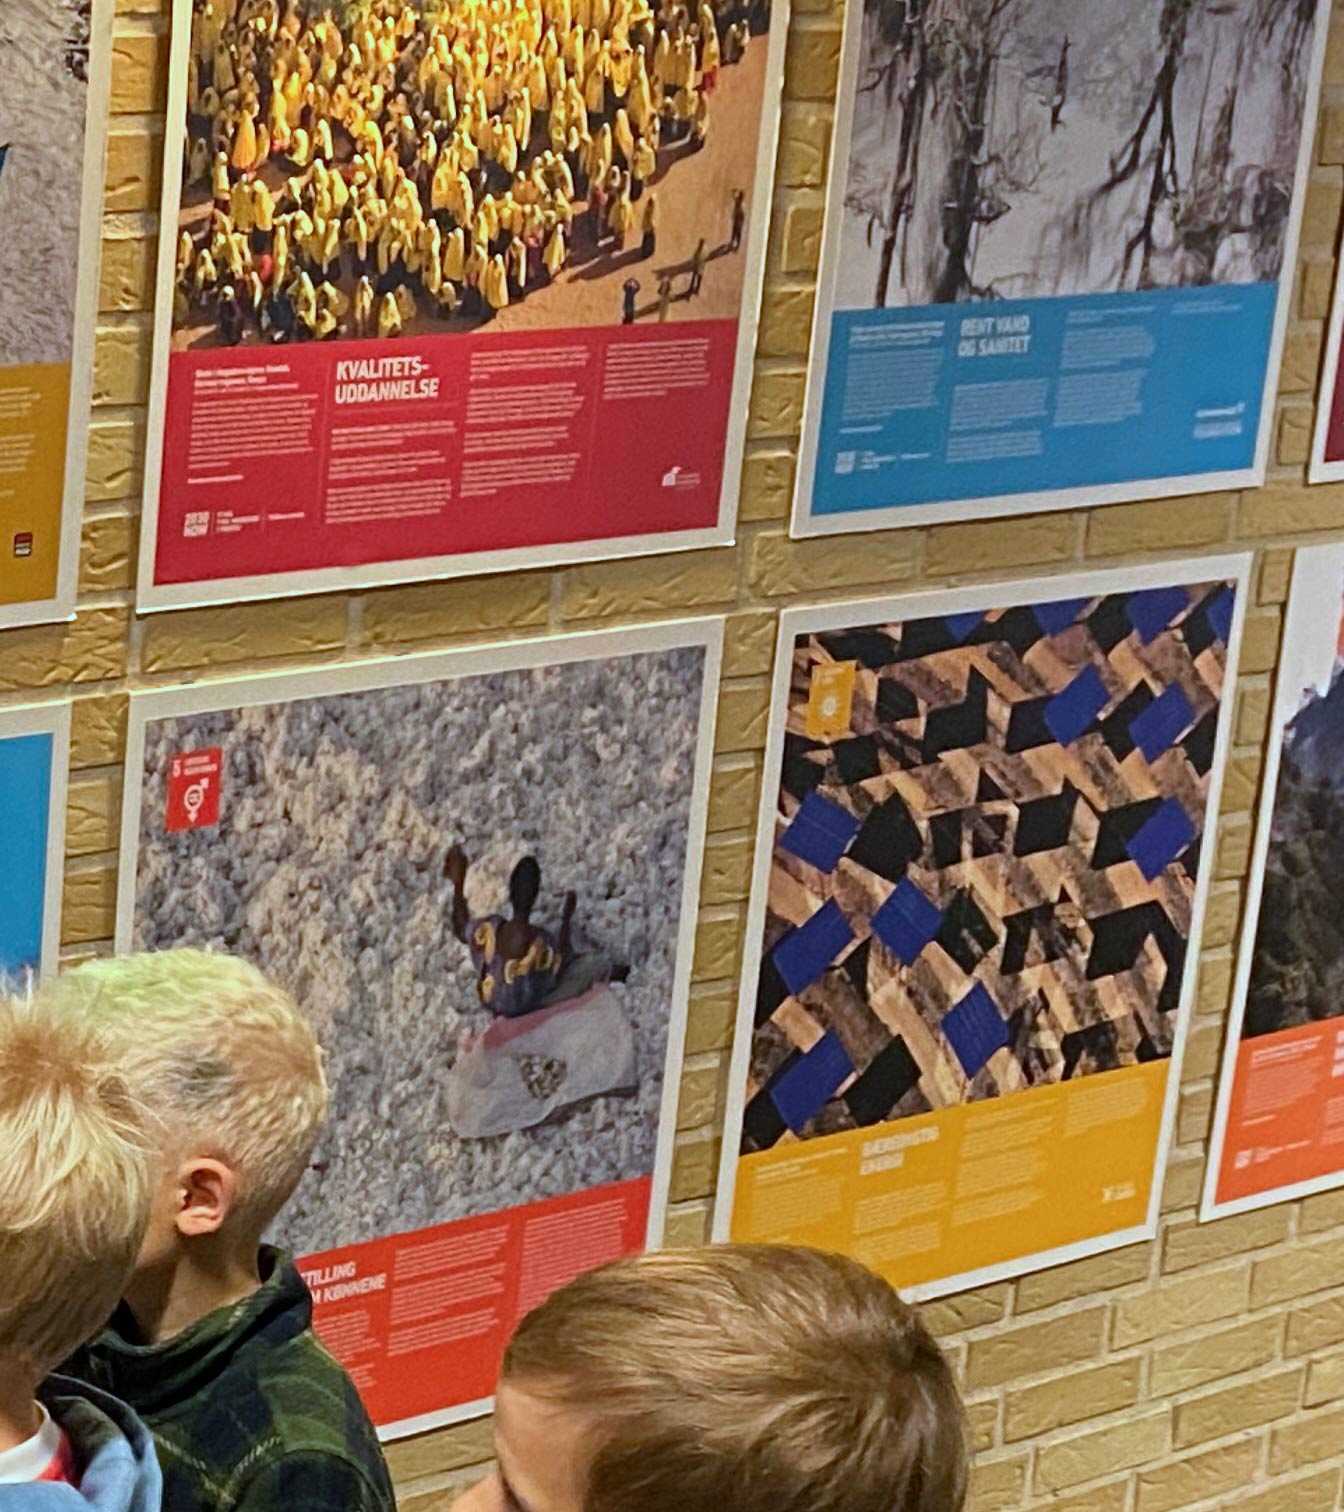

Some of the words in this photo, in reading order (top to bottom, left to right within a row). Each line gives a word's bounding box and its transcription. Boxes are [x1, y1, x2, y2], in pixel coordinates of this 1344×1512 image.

[960, 318, 994, 338] RENT
[336, 357, 430, 382] KVALITETS-
[334, 377, 440, 405] UDDANNELSE
